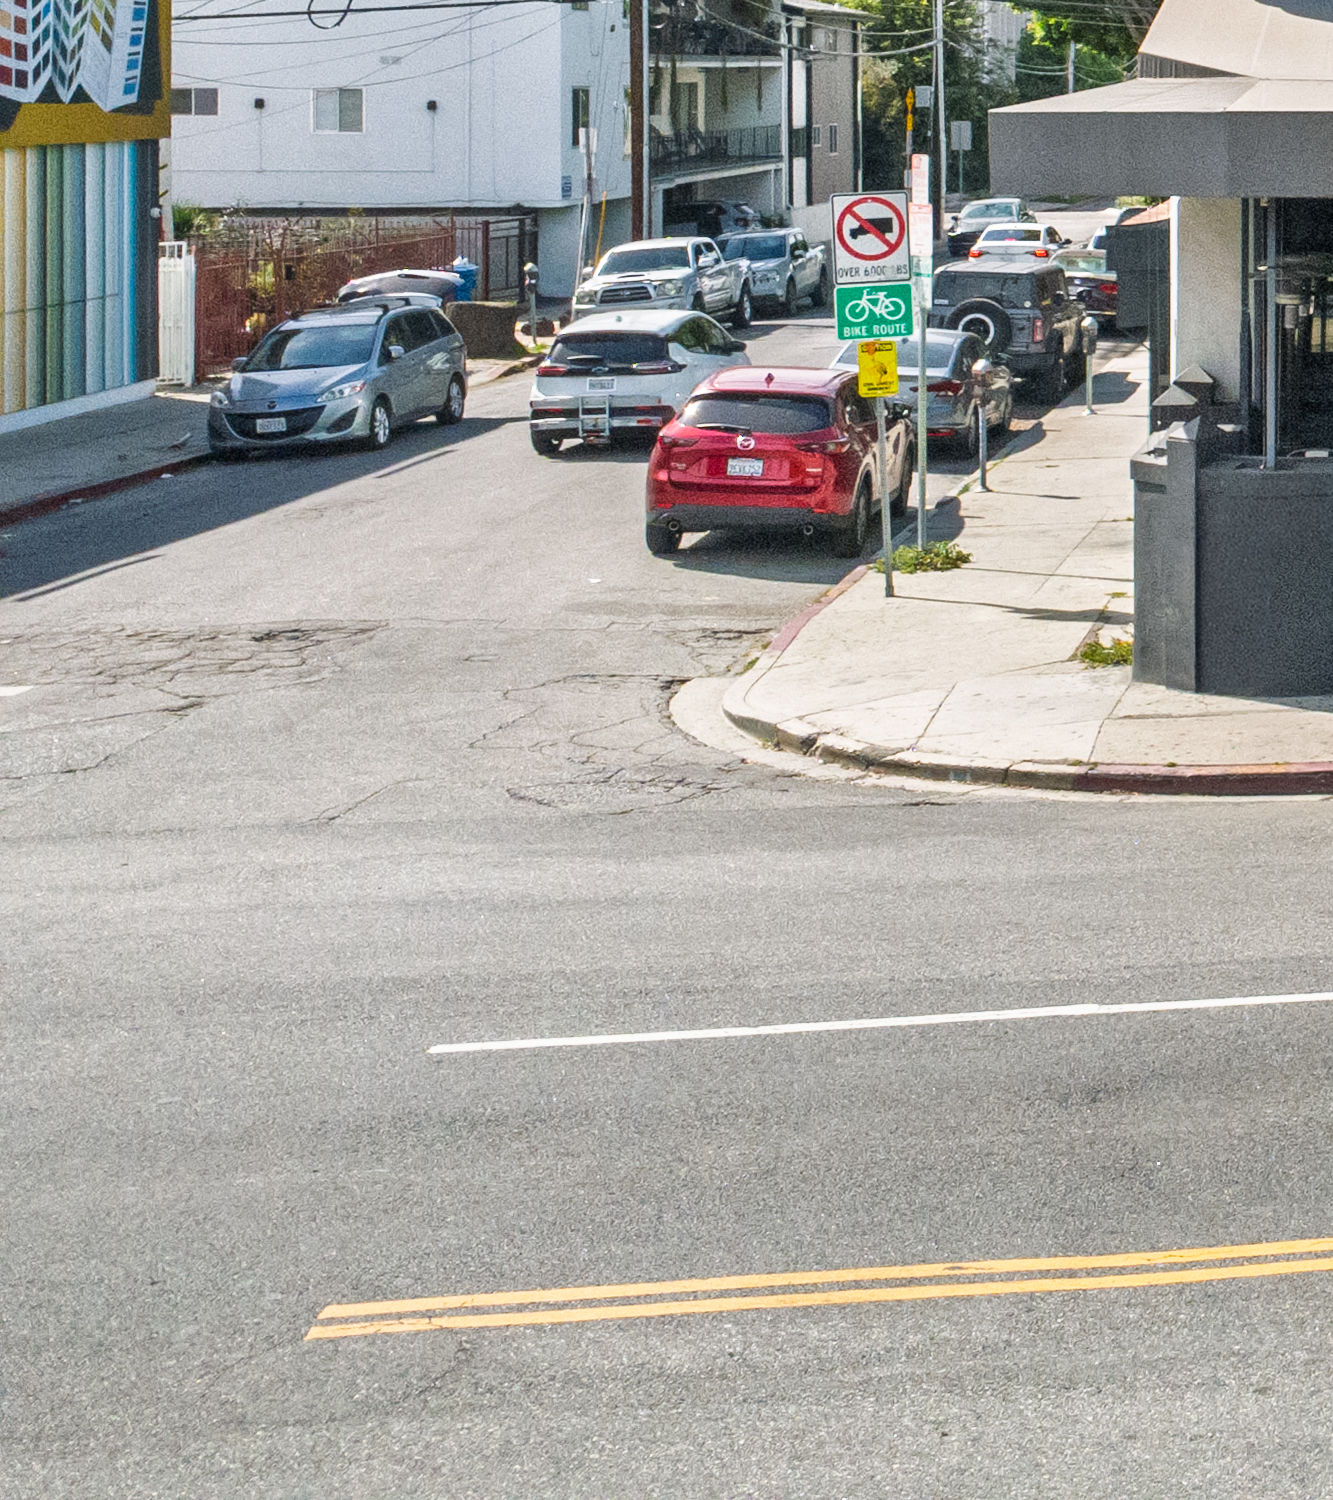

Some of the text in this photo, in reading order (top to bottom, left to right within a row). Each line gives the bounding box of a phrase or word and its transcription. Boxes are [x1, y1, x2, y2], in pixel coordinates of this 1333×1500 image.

[838, 267, 860, 278] OVER
[843, 323, 908, 338] BIKE ROUTE
